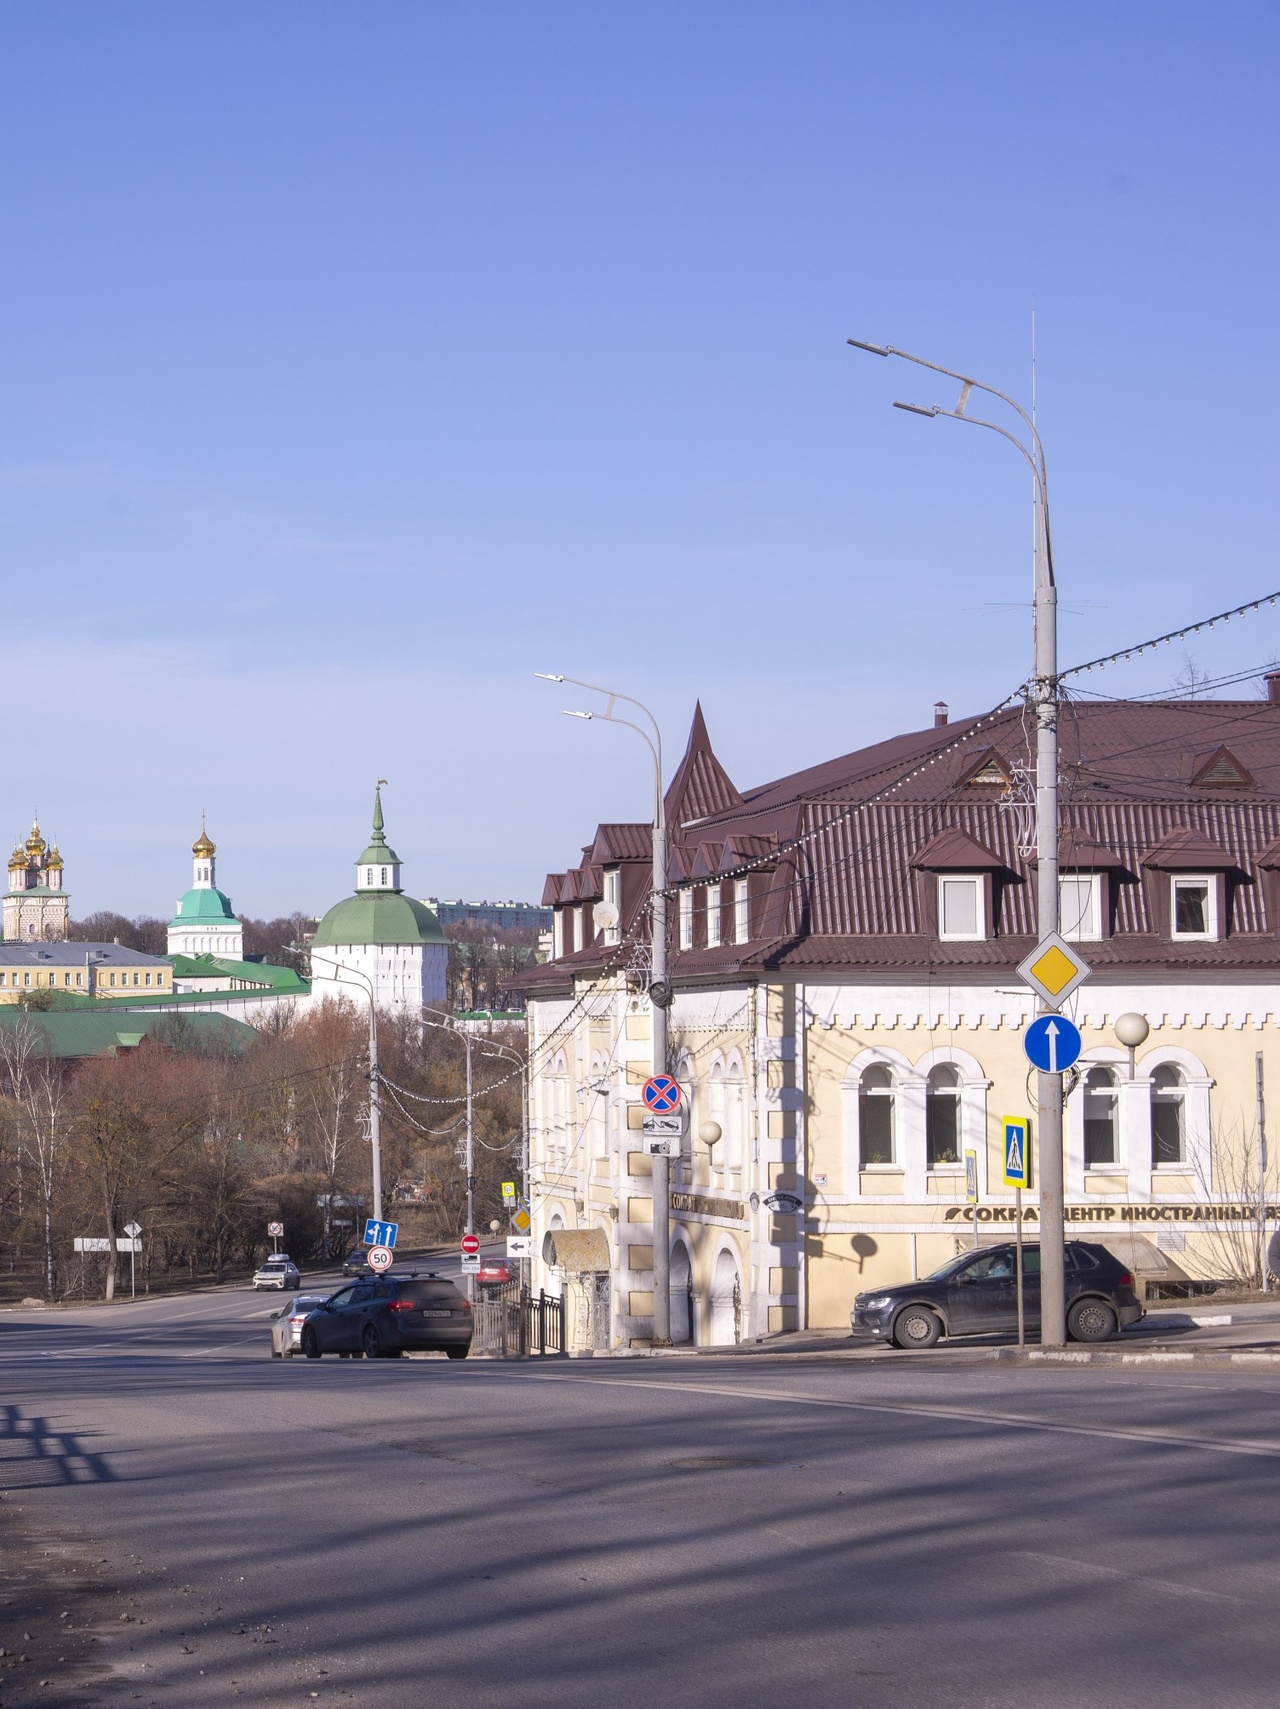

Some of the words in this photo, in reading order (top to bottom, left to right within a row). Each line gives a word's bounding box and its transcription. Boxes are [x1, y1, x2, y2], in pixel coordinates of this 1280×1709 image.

[963, 1206, 1040, 1221] СОКРА
[1121, 1206, 1258, 1220] ИНОСТРАННЫХ
[373, 1253, 387, 1263] 50
